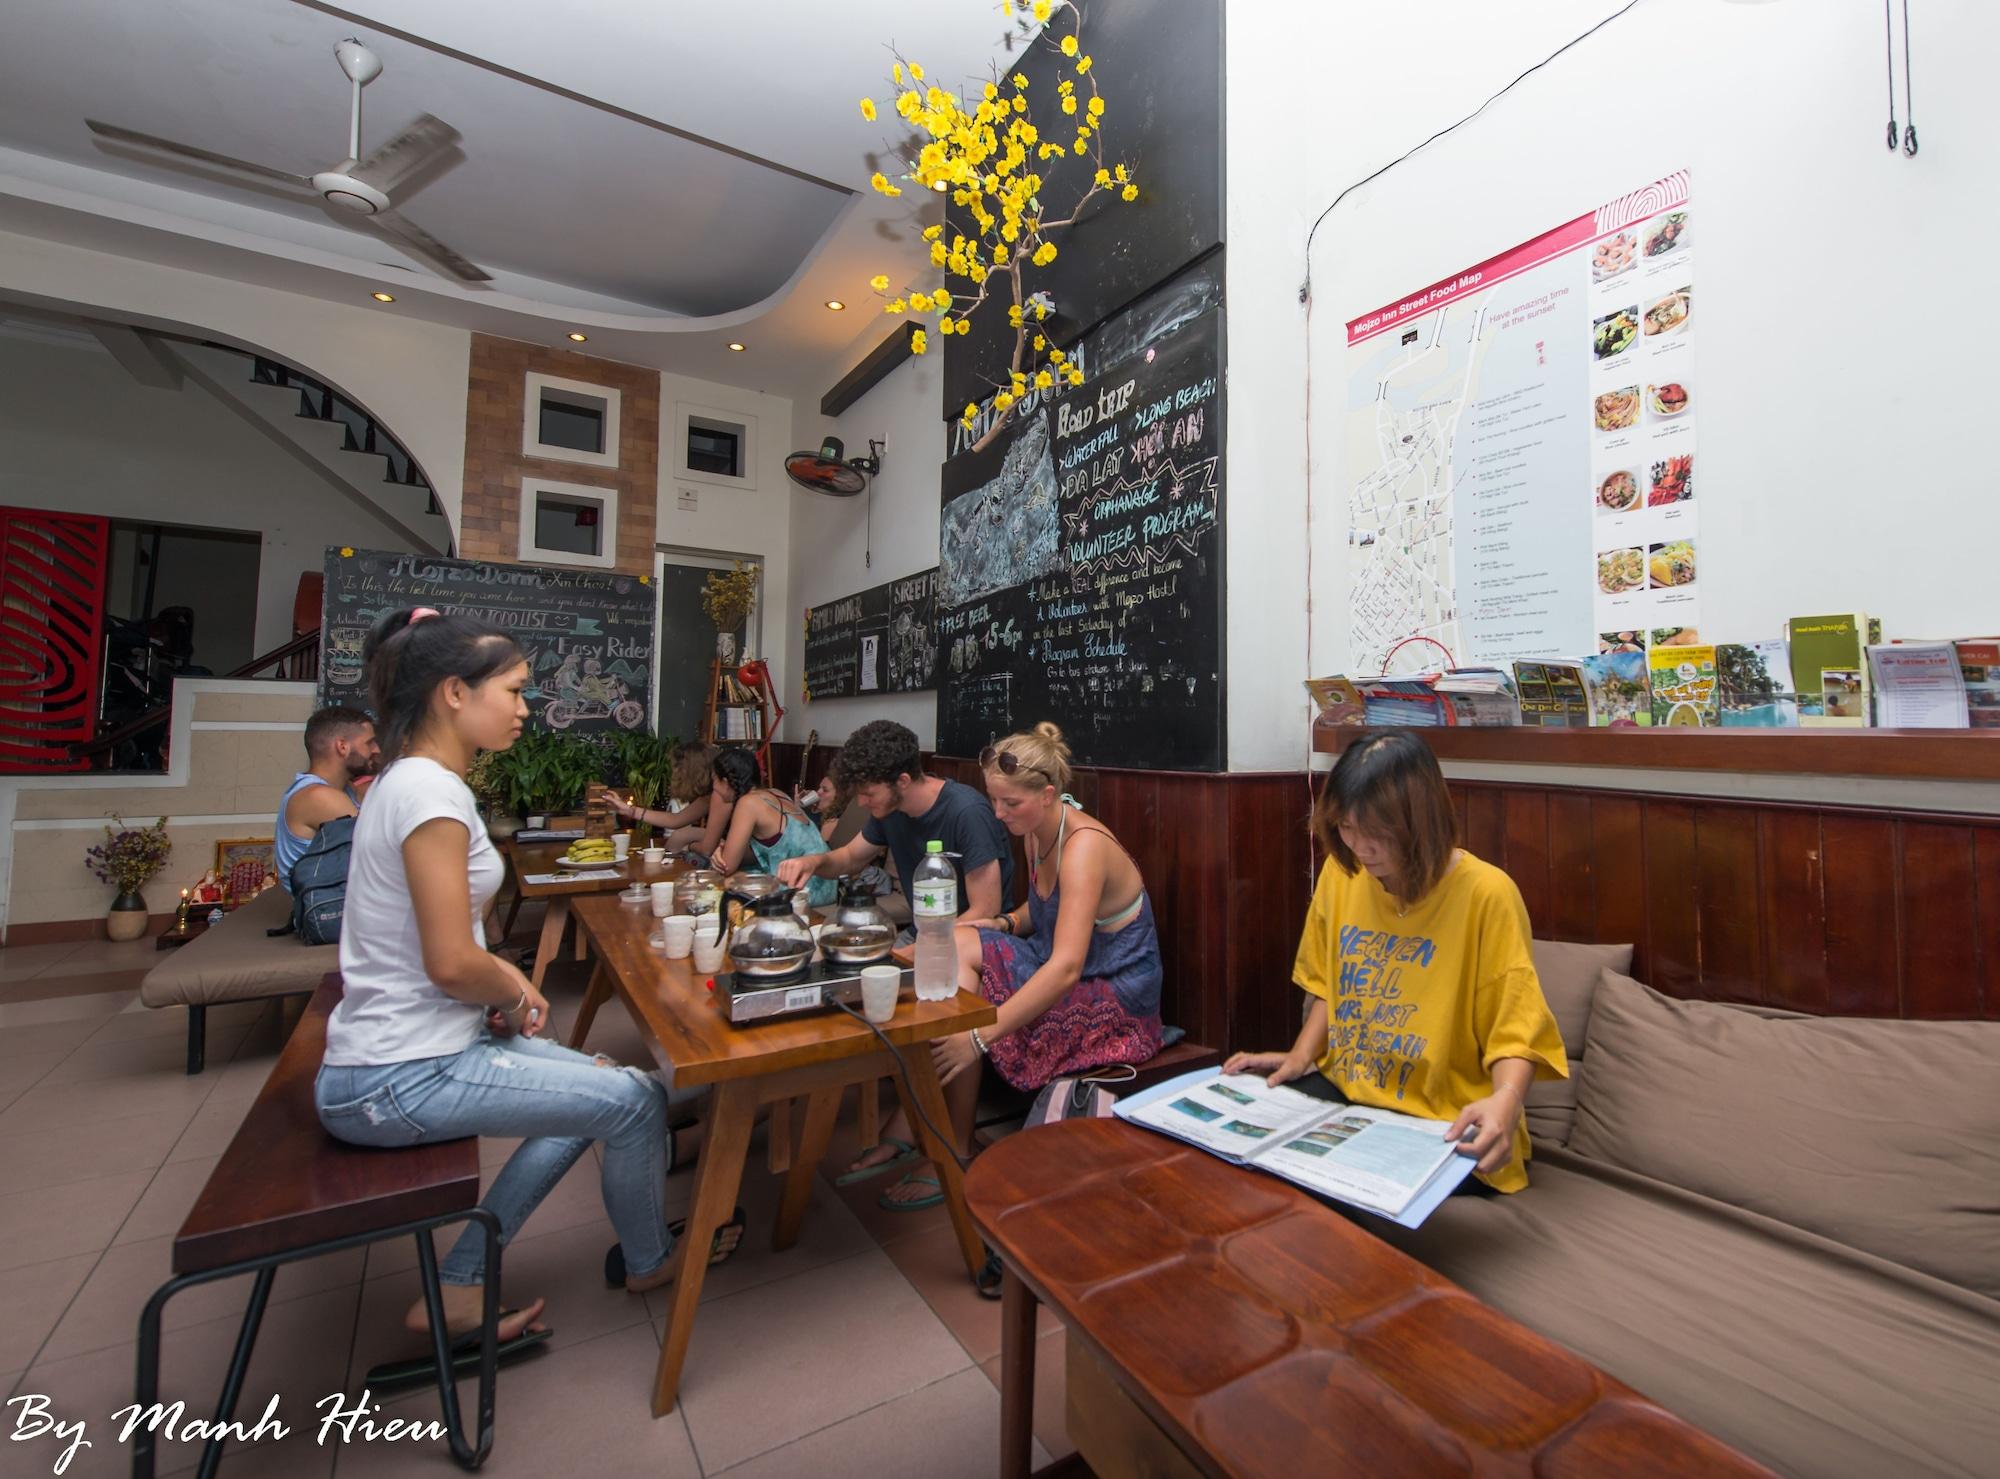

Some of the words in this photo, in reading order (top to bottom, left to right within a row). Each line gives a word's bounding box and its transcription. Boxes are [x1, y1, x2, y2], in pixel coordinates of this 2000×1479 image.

[1354, 318, 1380, 335] Mojzo
[1383, 310, 1397, 322] Inn
[1399, 295, 1428, 314] Street
[1430, 282, 1456, 301] Food
[1459, 272, 1482, 289] Map
[1489, 311, 1510, 323] Have
[1141, 396, 1172, 429] LONG
[1175, 378, 1216, 410] BEACH
[1171, 407, 1205, 449] AN
[1094, 480, 1160, 520] ORPHANAGE
[1070, 525, 1136, 562] VOLUNTEER
[1143, 496, 1205, 543] PROGRAM
[361, 576, 384, 592] this
[558, 636, 603, 660] Easy
[606, 636, 650, 659] Rider
[1339, 925, 1437, 968] HEAVEN
[1338, 961, 1402, 1000] HELL
[1335, 1000, 1362, 1022] ARE
[1365, 1000, 1418, 1028] JUST
